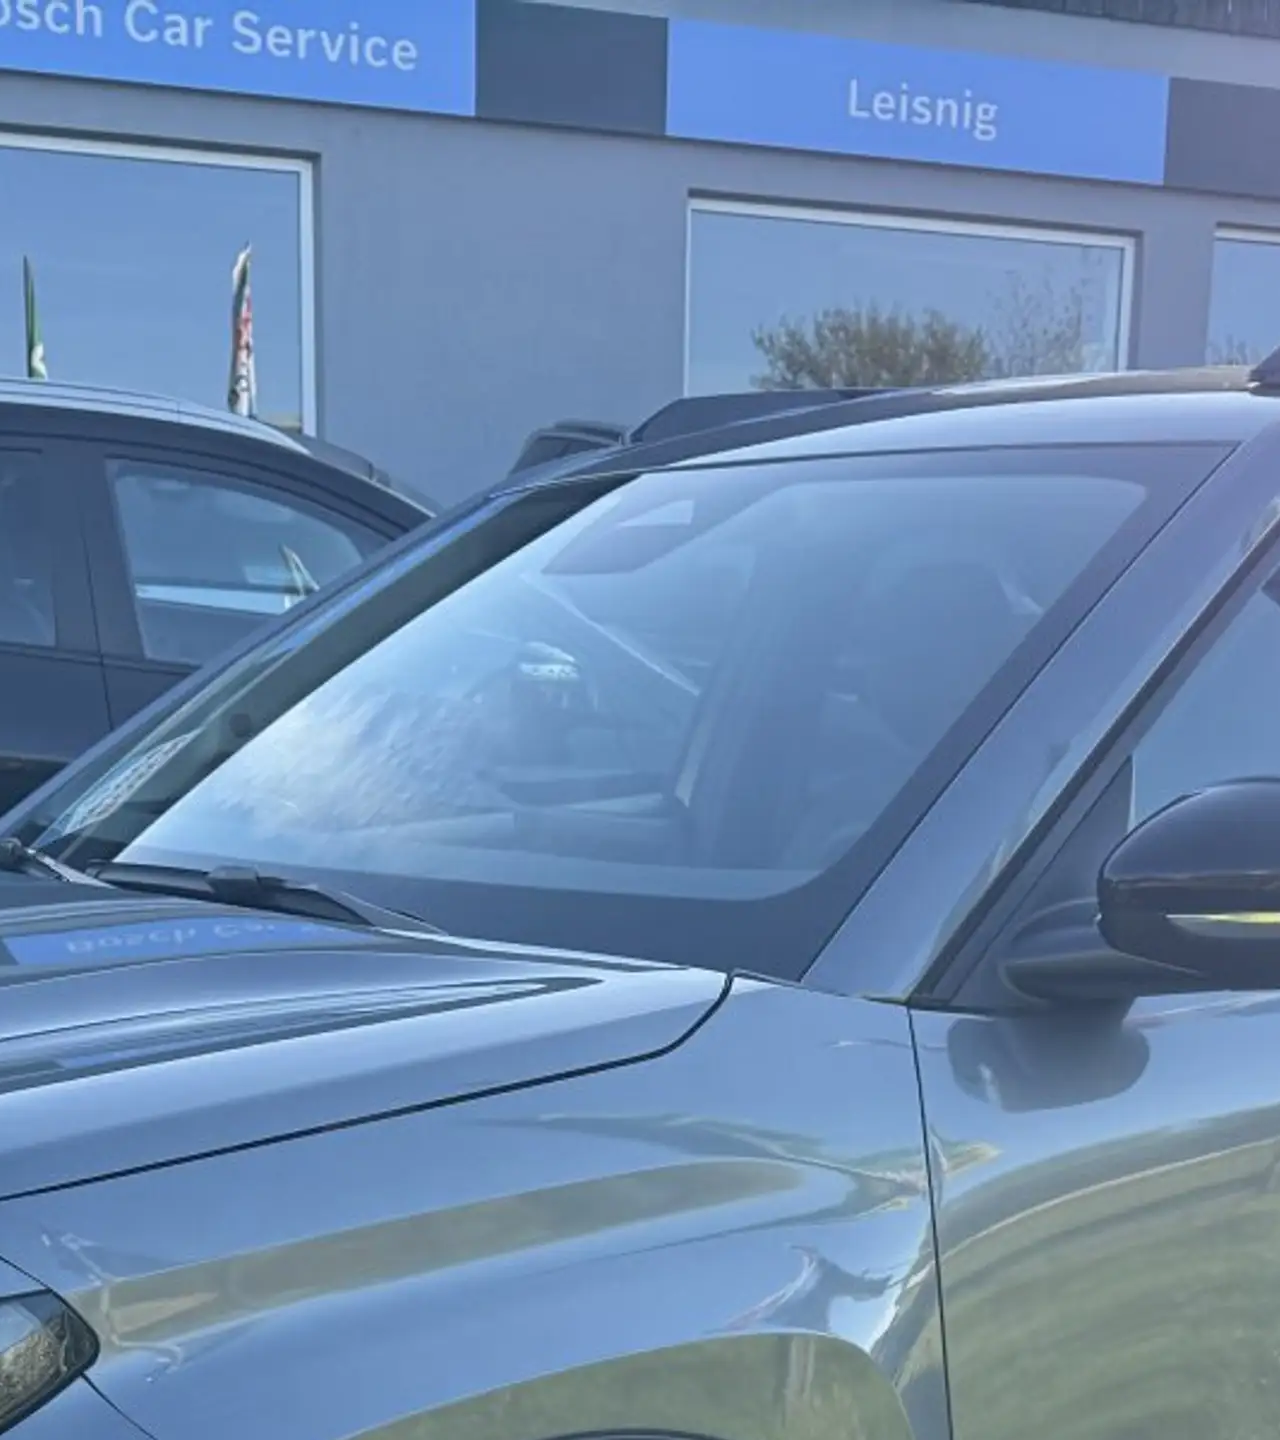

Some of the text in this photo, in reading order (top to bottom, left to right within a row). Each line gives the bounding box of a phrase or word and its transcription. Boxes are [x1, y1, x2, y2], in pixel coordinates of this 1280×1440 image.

[124, 0, 214, 48] Car
[232, 9, 418, 71] Service
[848, 78, 999, 142] Leisnig
